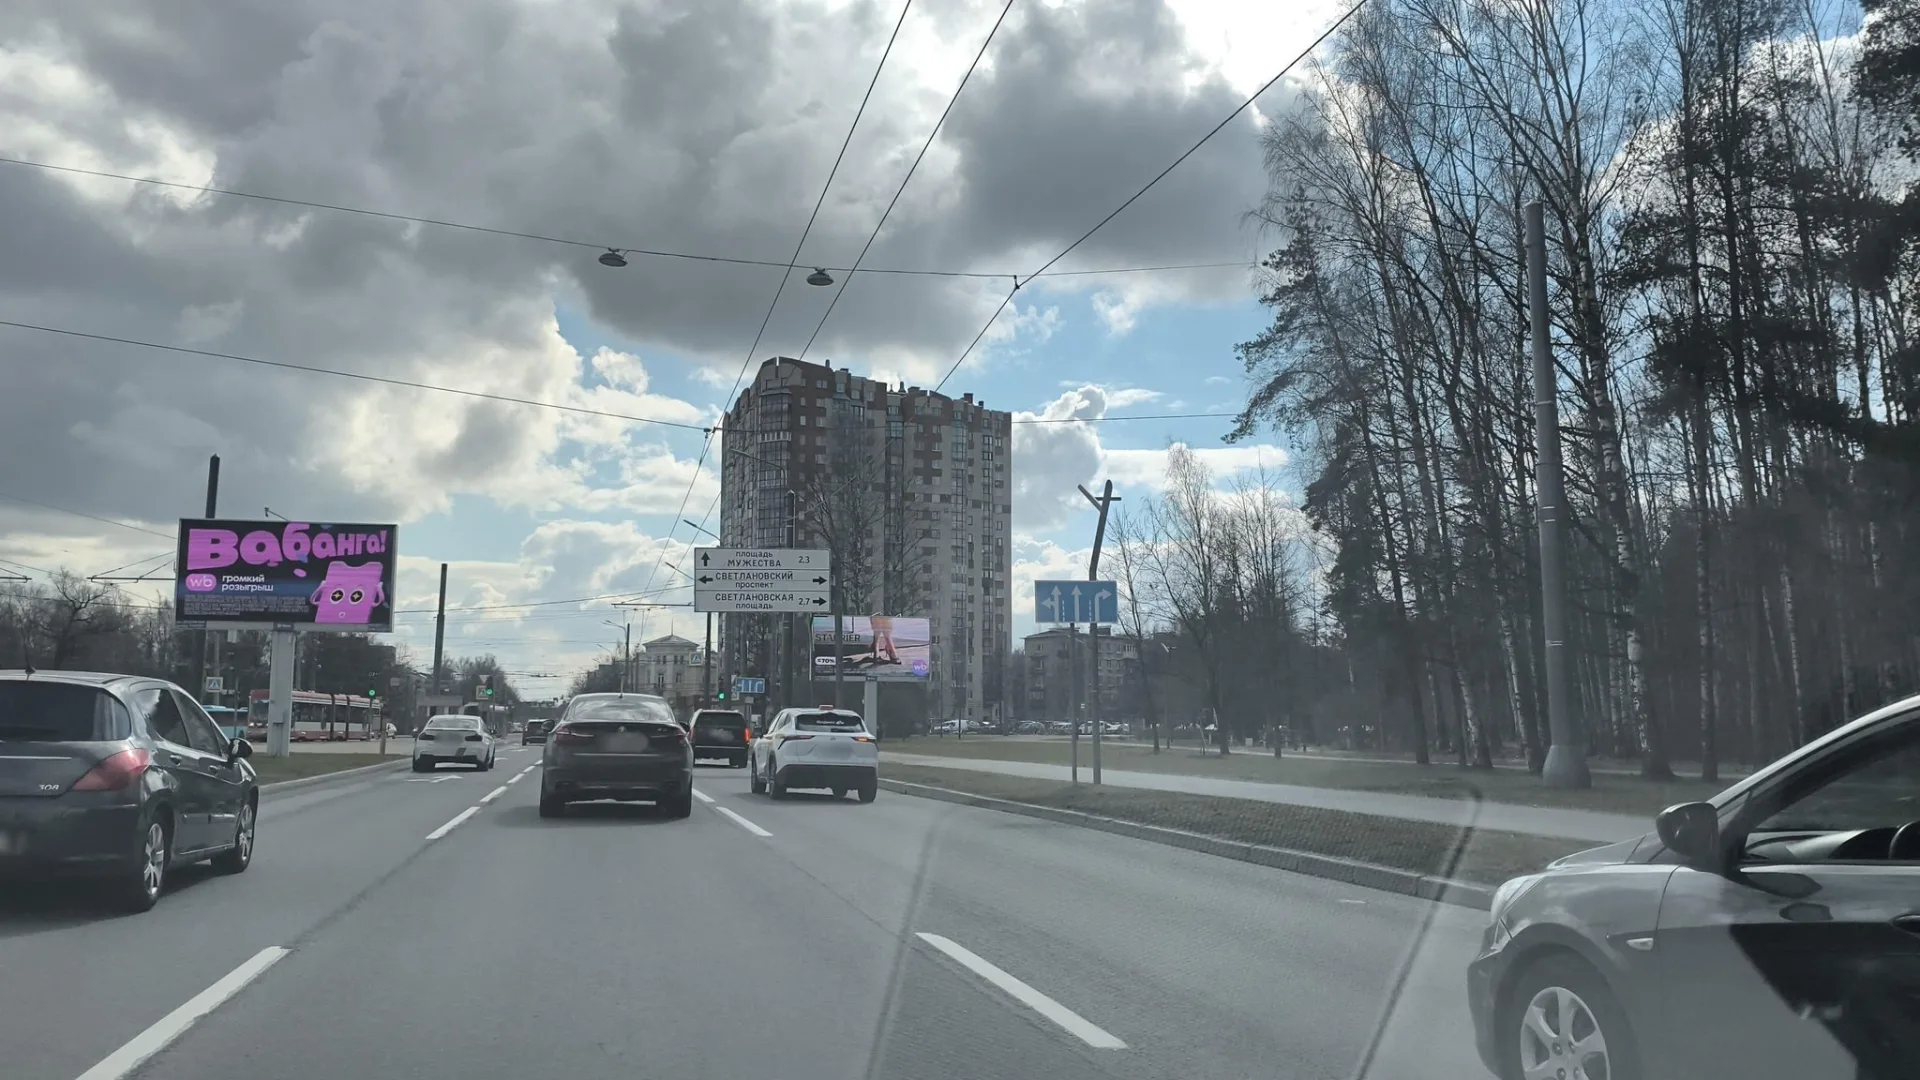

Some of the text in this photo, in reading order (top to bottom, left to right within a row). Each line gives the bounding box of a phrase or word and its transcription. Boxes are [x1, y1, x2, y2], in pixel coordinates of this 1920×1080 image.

[187, 522, 388, 571] Вабанга!
[735, 551, 773, 559] площадь
[727, 559, 782, 567] МУЖЕСТВА
[222, 574, 265, 583] громкий
[715, 571, 794, 580] СВЕТЛАНОВСКИЙ
[190, 575, 213, 588] wb
[735, 581, 774, 589] проспект
[221, 583, 274, 593] розыгрыш
[715, 593, 794, 602] СВЕТЛАНОВСКАЯ
[798, 598, 810, 606] 2,7
[735, 602, 773, 610] площадь
